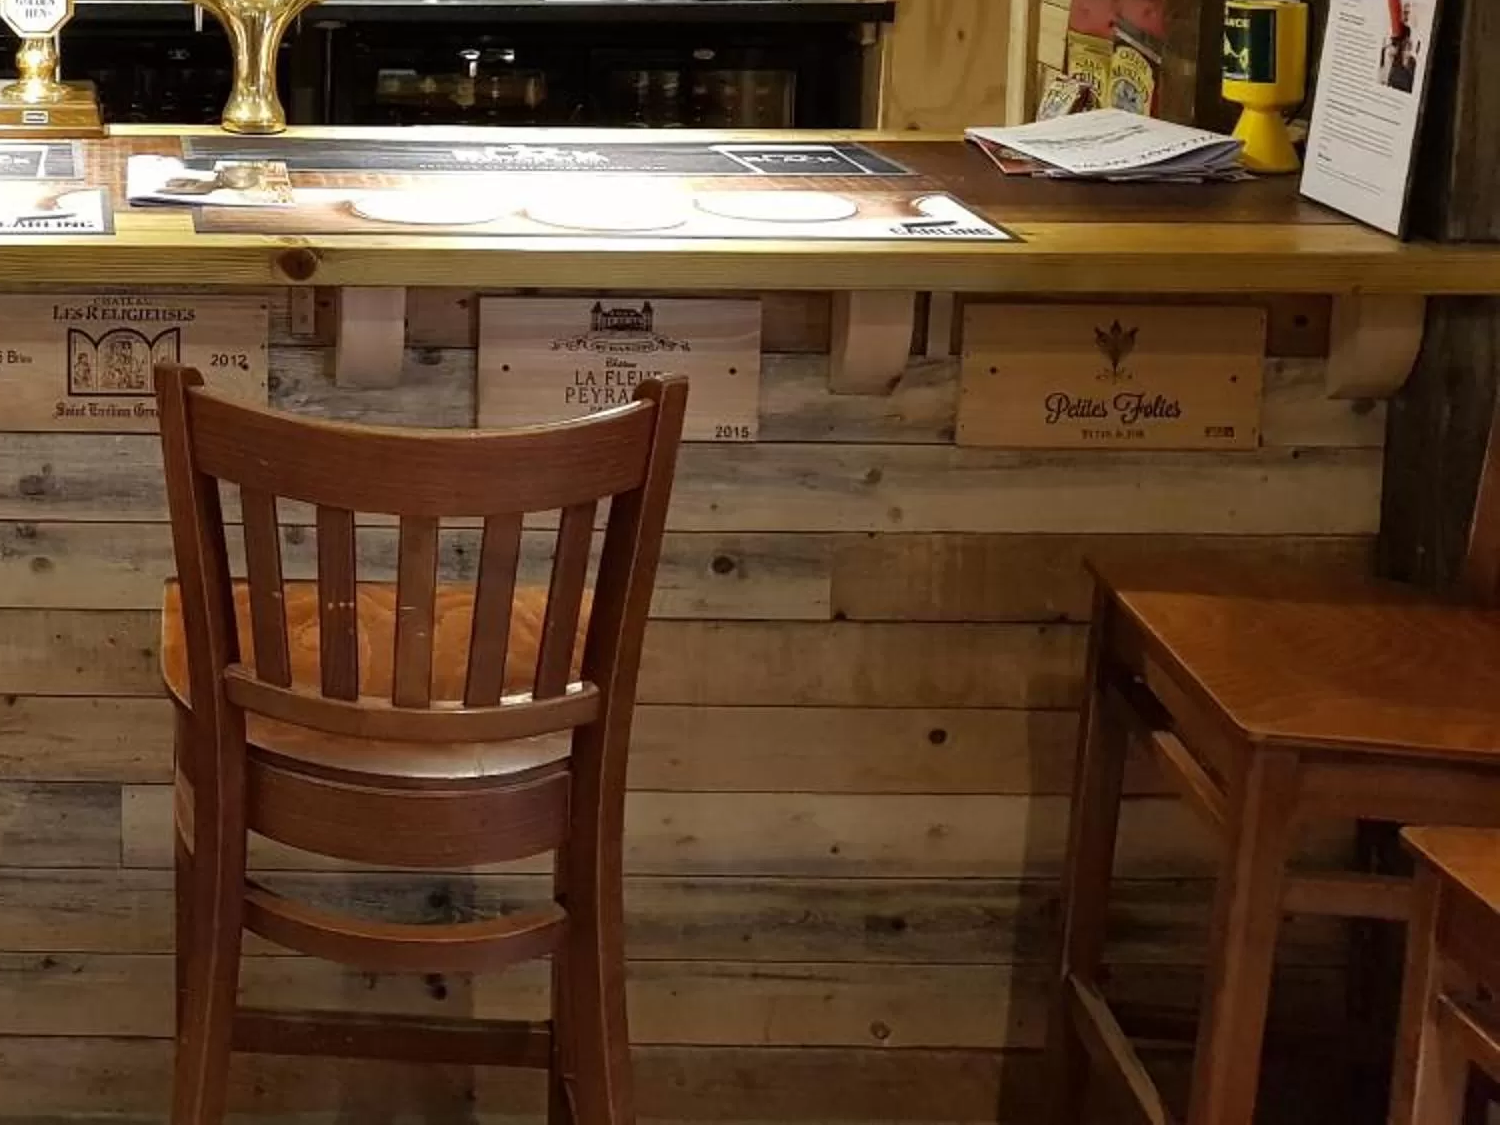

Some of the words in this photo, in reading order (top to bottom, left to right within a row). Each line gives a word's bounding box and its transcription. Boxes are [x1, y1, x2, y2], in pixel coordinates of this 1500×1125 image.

[209, 354, 249, 368] 2012
[575, 370, 597, 386] LA
[604, 369, 663, 387] FLEU
[565, 386, 638, 405] PEYRA
[1045, 391, 1109, 424] Petites
[1113, 391, 1183, 425] Folies
[714, 425, 750, 439] 2015
